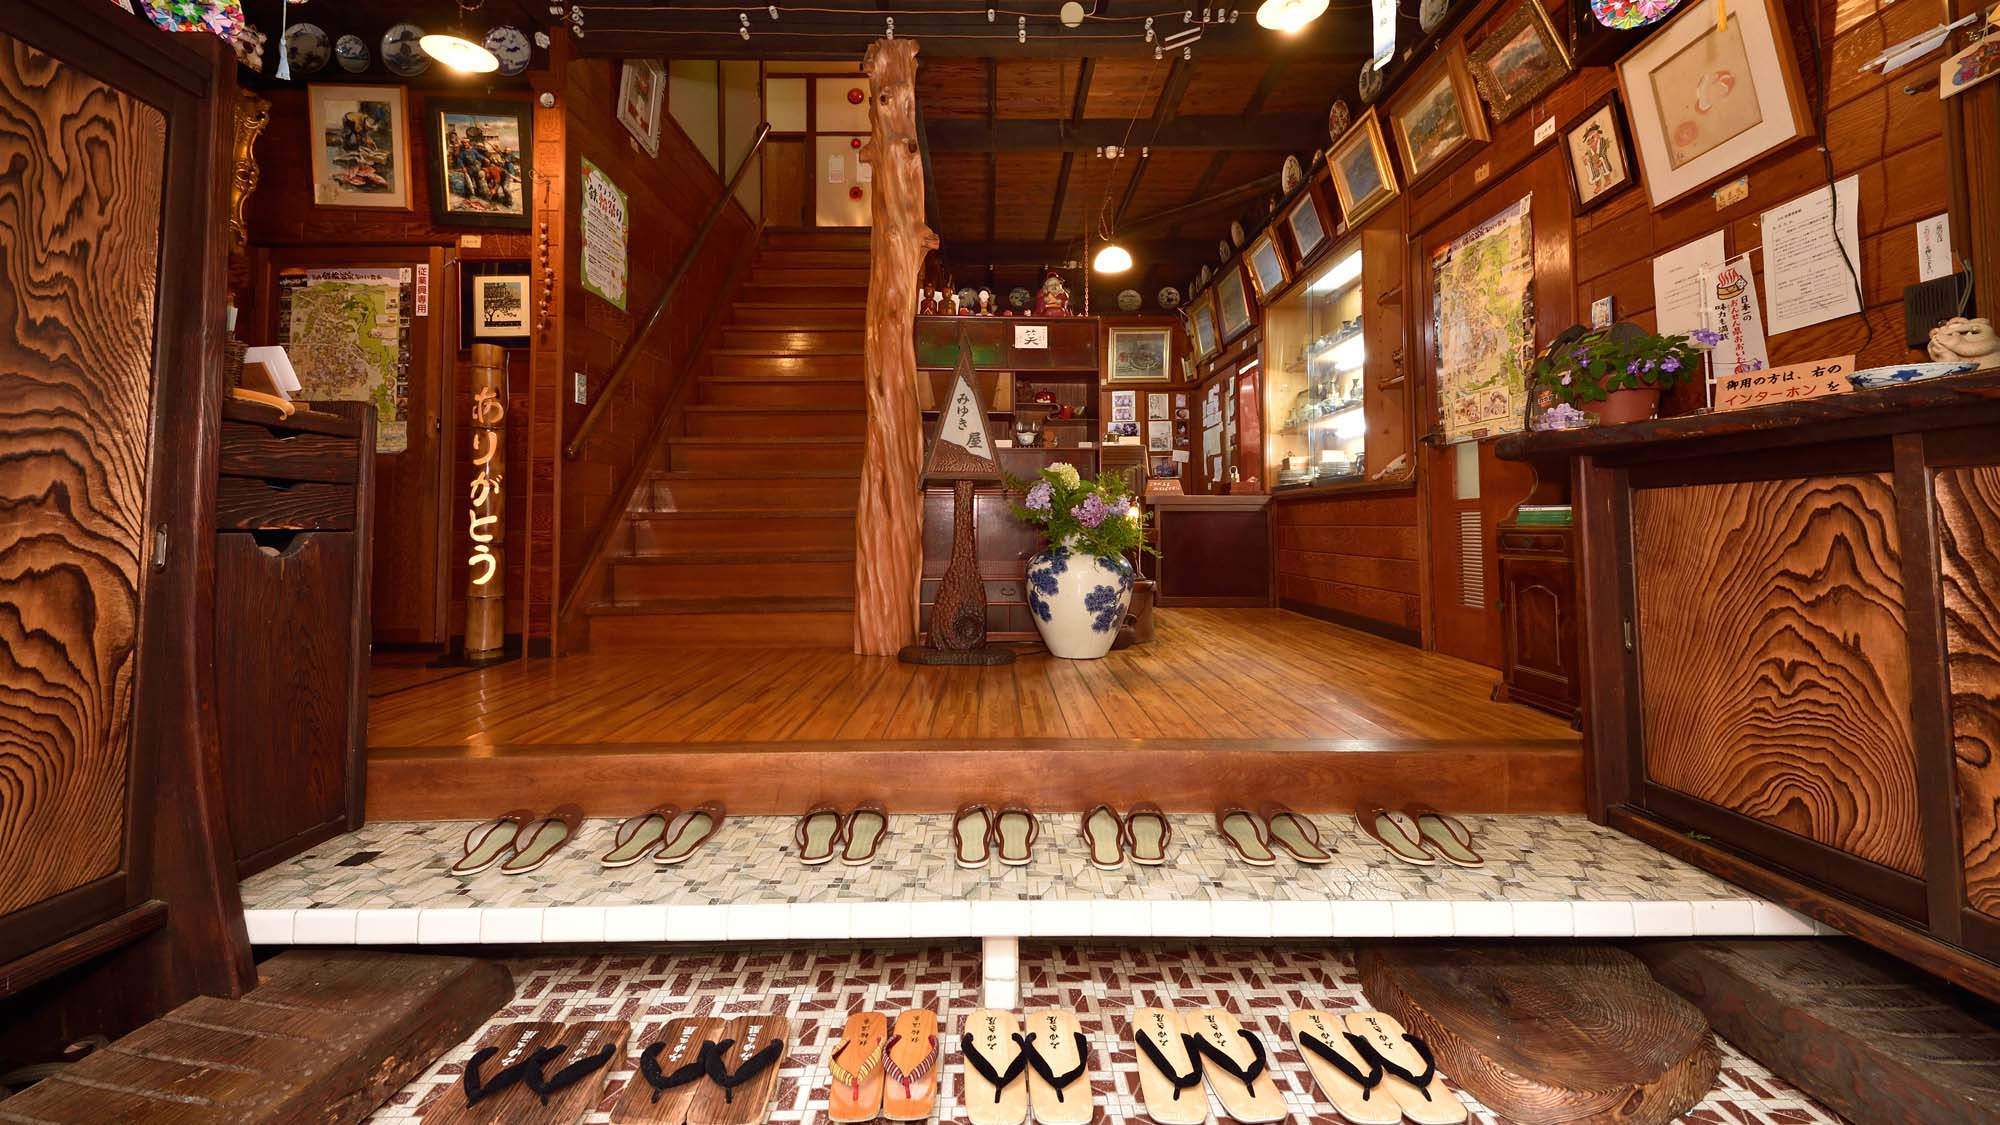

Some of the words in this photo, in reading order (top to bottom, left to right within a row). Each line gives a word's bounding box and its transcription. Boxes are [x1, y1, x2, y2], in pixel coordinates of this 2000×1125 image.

[417, 266, 428, 313] 従業員専用
[1740, 295, 1752, 321] 日本一の
[1024, 329, 1040, 346] 笑
[1714, 304, 1730, 342] 味力も満載
[1725, 385, 1817, 406] インターホン
[956, 393, 983, 449] みゆき屋
[468, 386, 505, 585] ありがとう
